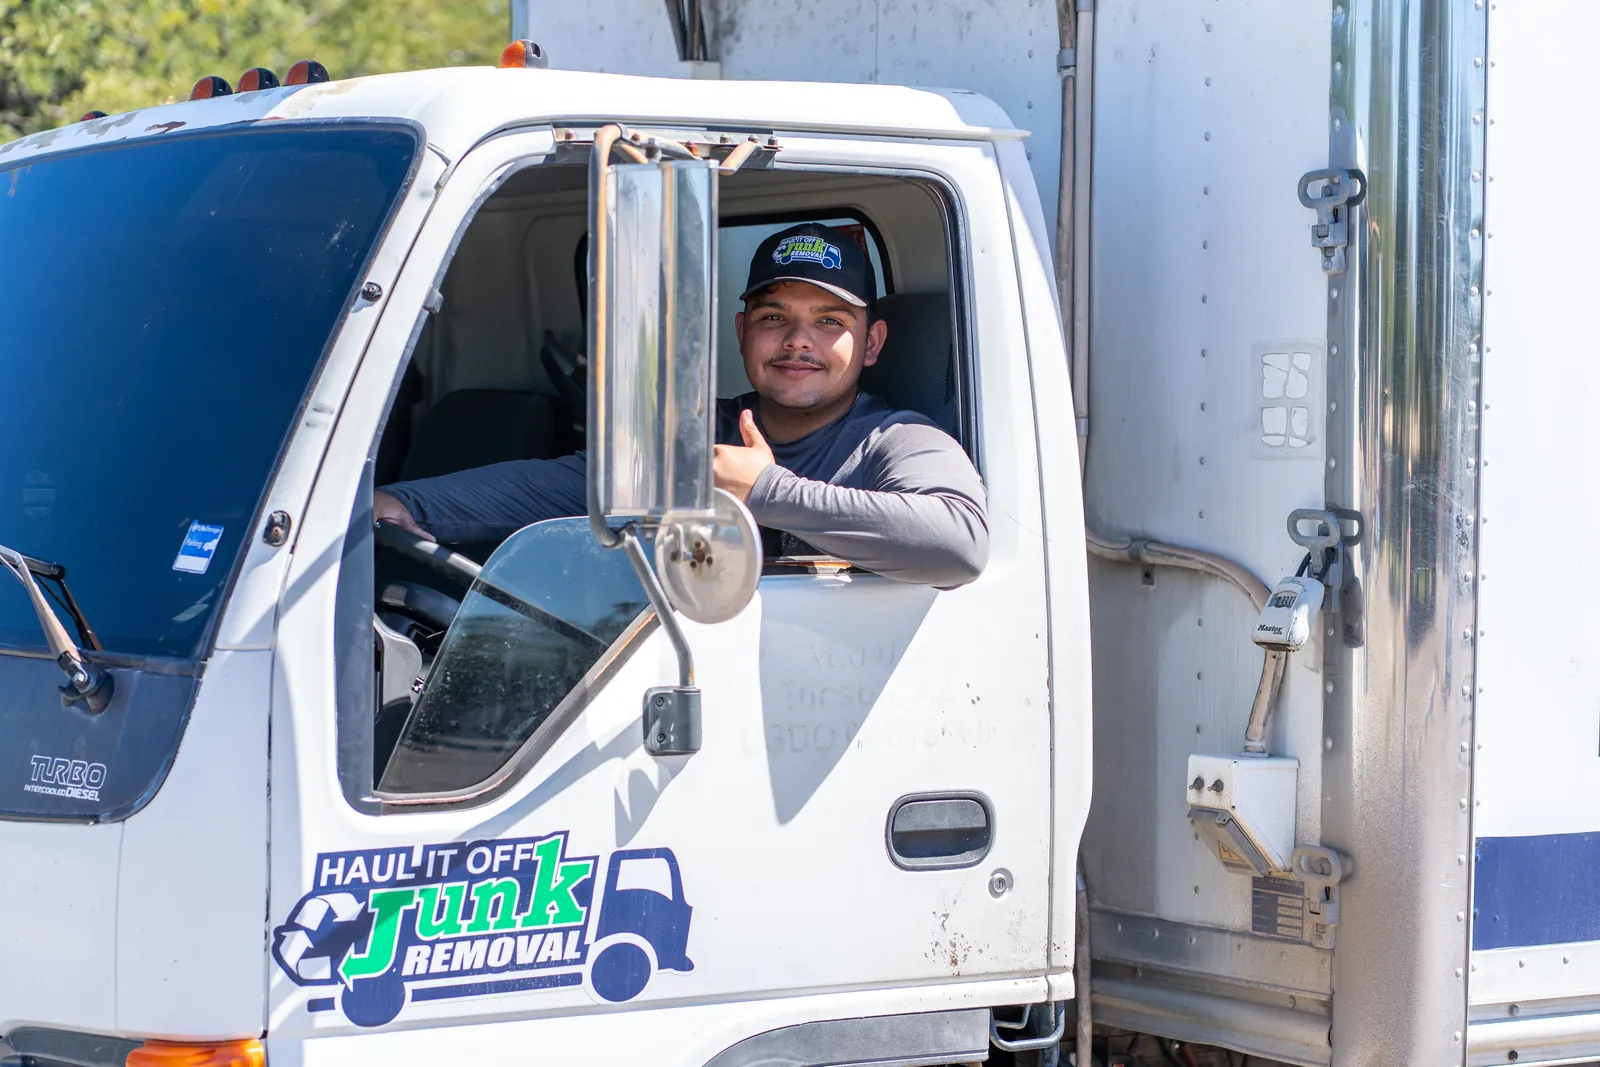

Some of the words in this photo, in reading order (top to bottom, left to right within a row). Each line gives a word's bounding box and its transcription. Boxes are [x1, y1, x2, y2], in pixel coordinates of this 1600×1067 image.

[782, 239, 825, 257] Junk
[790, 250, 823, 258] REMOVAL
[31, 755, 107, 789] TURBO
[24, 784, 66, 796] INTERCOOLED
[65, 787, 100, 802] DIESEL
[319, 852, 416, 887] HAUL
[425, 848, 450, 878] IT
[466, 842, 536, 877] OFF
[339, 833, 596, 990] Junk
[401, 930, 583, 976] REMOVAL
